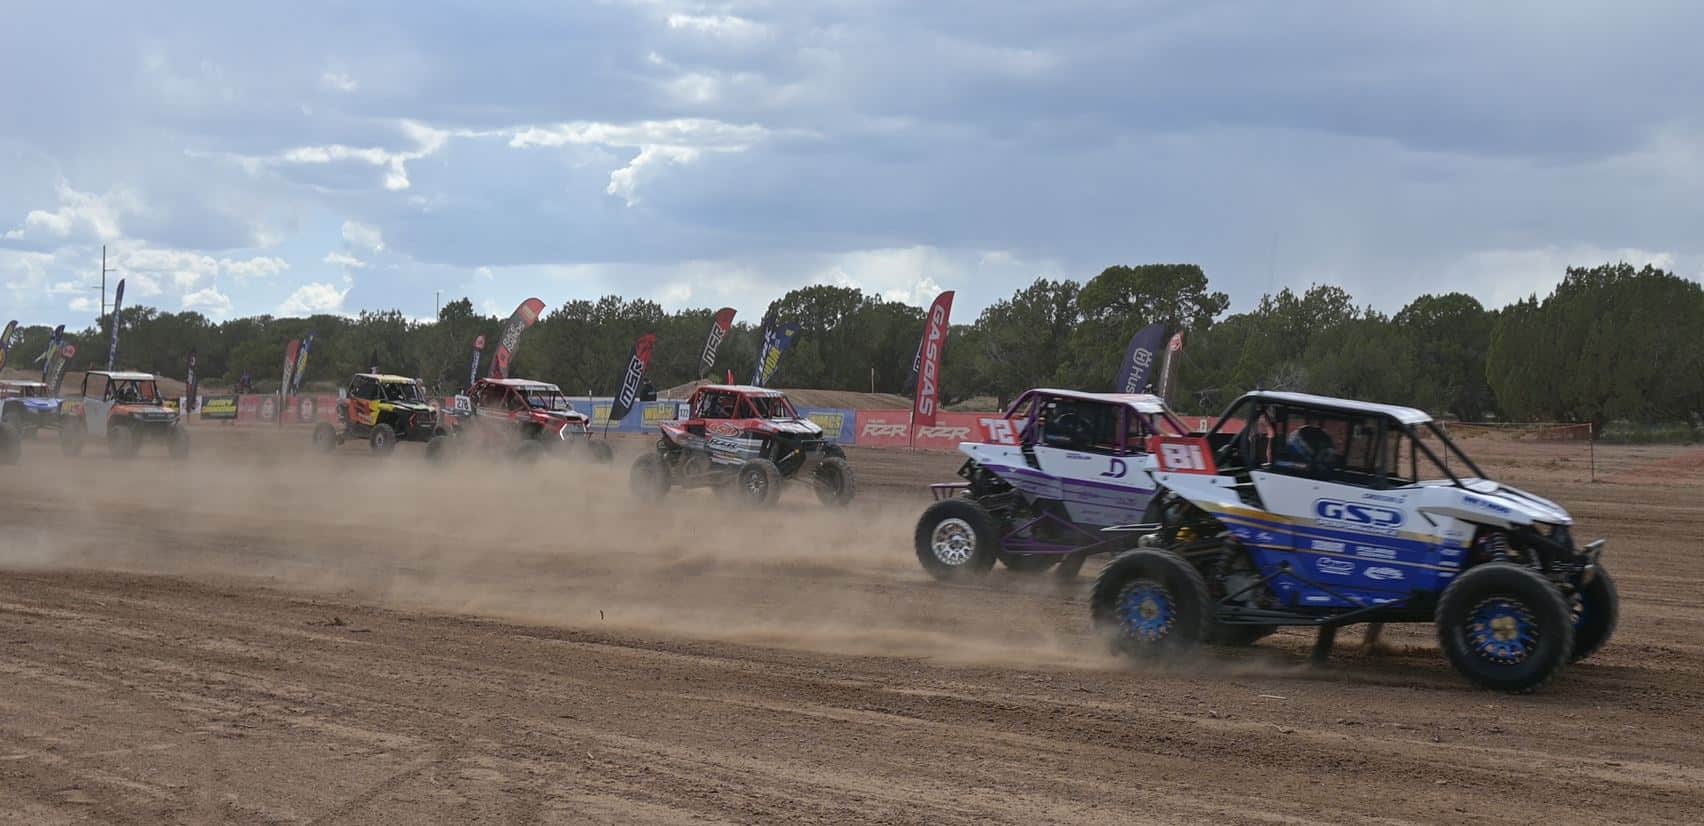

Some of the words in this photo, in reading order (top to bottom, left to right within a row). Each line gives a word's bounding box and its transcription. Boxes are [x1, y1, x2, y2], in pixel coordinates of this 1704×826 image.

[702, 321, 728, 367] MSR
[919, 304, 945, 417] GASGAS
[619, 354, 645, 409] MSR
[862, 424, 907, 438] RZR
[917, 426, 970, 440] RZR
[1160, 443, 1207, 470] 81
